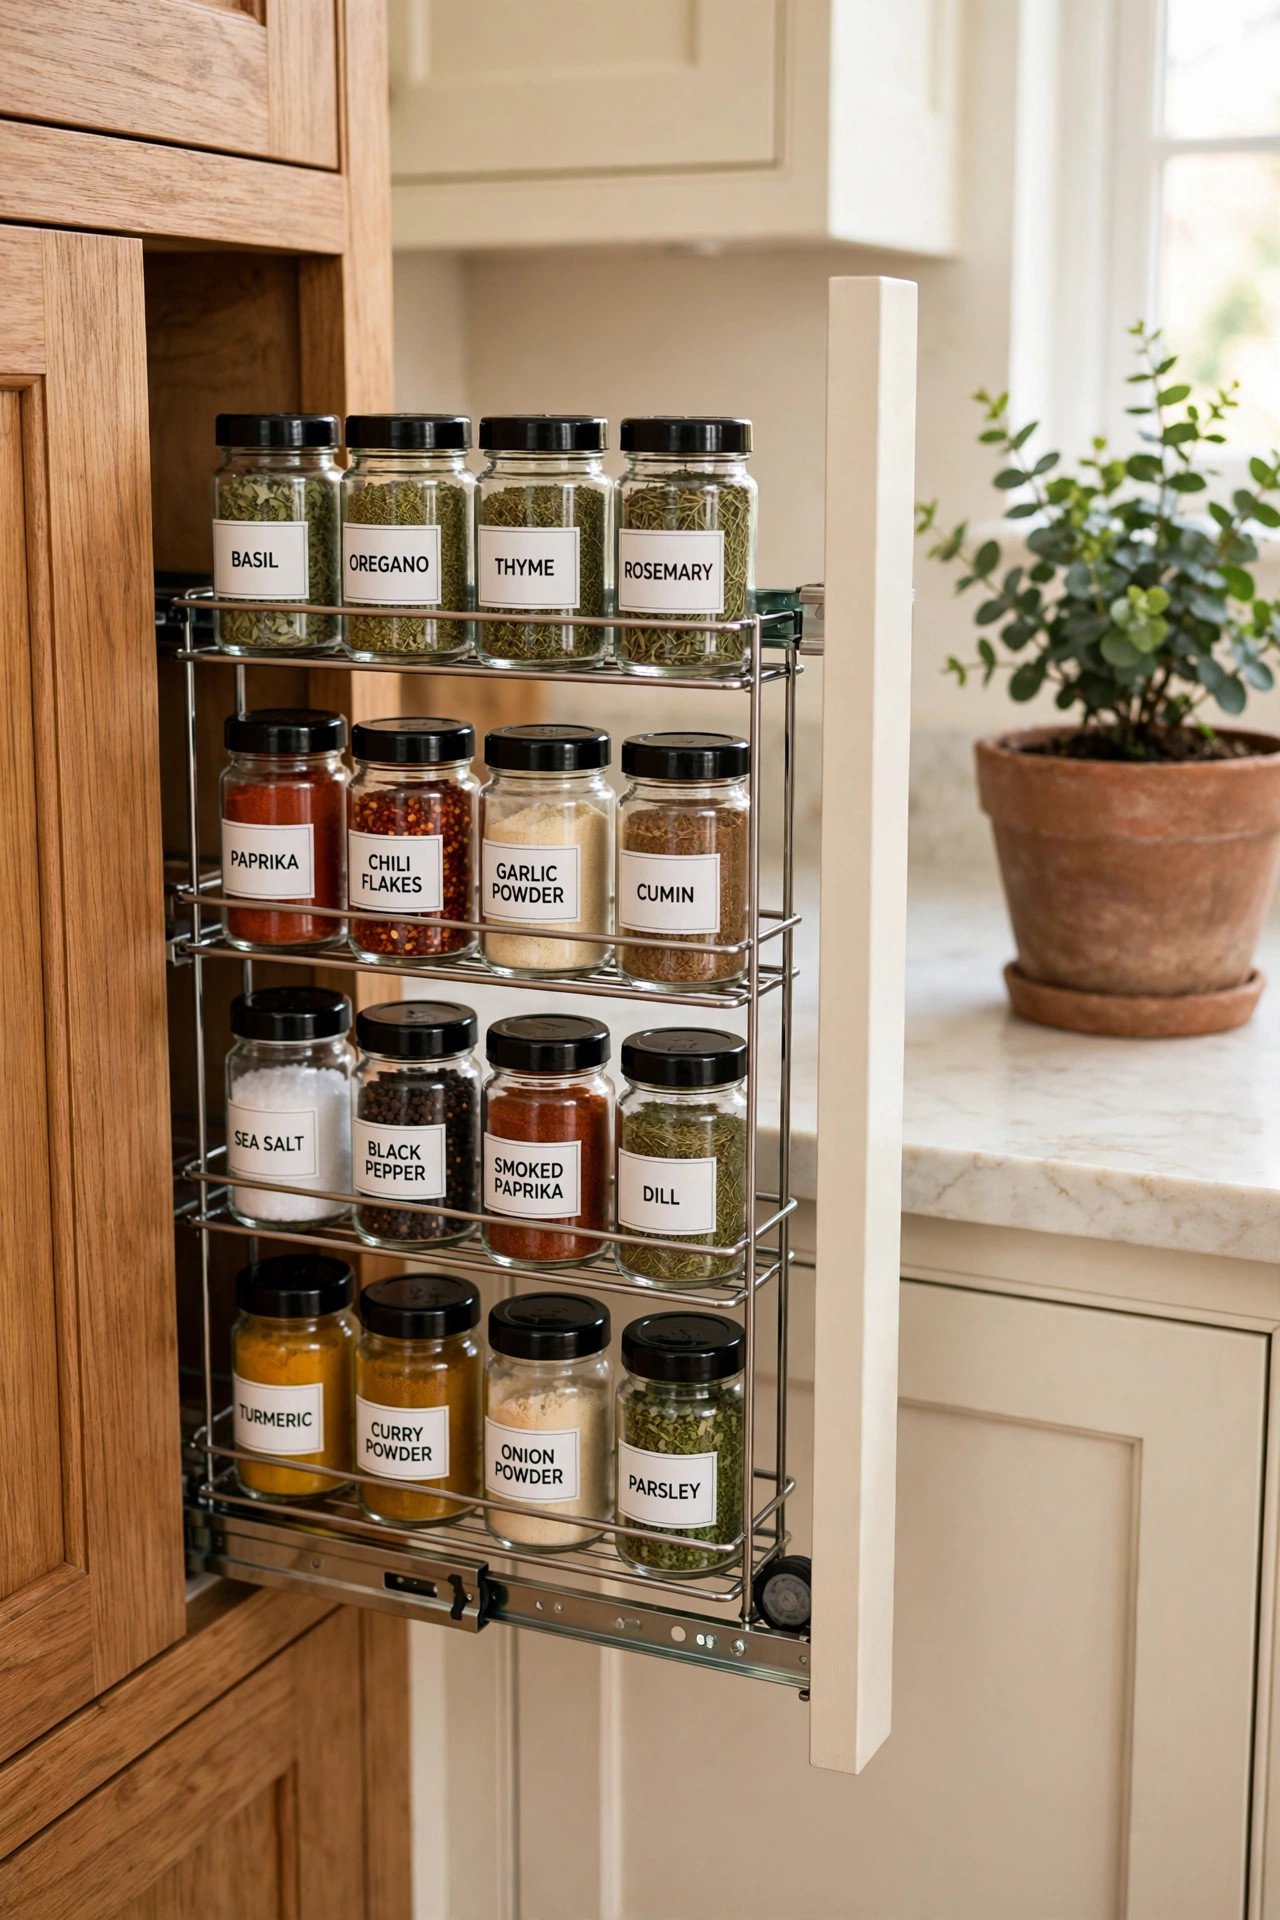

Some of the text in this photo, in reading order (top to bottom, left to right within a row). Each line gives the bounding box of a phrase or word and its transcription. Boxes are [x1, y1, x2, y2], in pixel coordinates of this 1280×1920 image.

[231, 550, 279, 569] BASIL
[349, 553, 429, 573] OREGANO
[494, 557, 555, 577] THYME
[624, 560, 713, 581] ROSEMARY
[230, 849, 300, 870] PAPRIKA
[368, 853, 411, 872] CHILI
[496, 862, 558, 883] GARLIC
[361, 873, 423, 894] FLAKES
[492, 882, 564, 904] POWDER
[636, 883, 694, 903] CUMIN
[234, 1130, 305, 1152] SEA SALT
[367, 1140, 421, 1161] BLACK
[365, 1159, 426, 1181] PEPPER
[494, 1156, 564, 1179] SMOKED
[494, 1177, 564, 1200] PAPRIKA
[643, 1185, 680, 1206] DILL
[238, 1402, 313, 1428] TURMERIC
[370, 1421, 424, 1442] CURRY
[365, 1441, 433, 1462] POWDER
[501, 1443, 555, 1465] ONION
[494, 1462, 563, 1485] POWDER
[628, 1474, 701, 1500] PARSLEY
